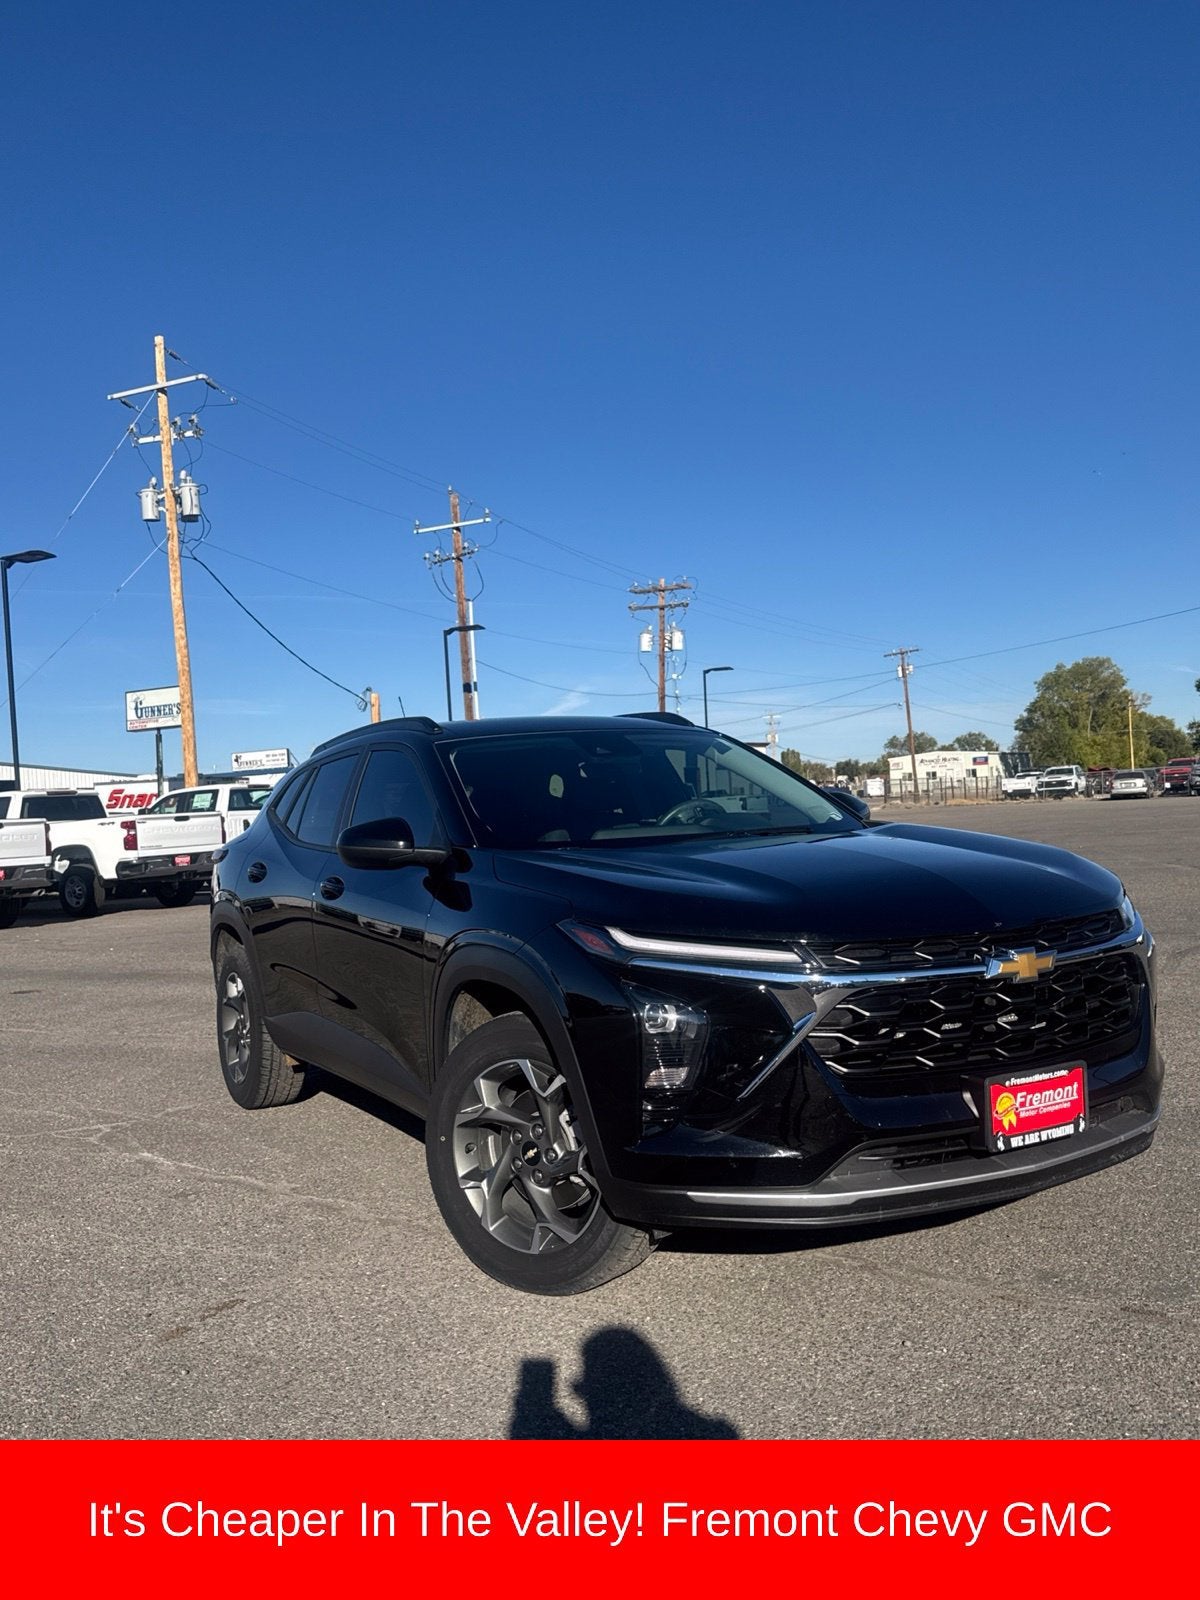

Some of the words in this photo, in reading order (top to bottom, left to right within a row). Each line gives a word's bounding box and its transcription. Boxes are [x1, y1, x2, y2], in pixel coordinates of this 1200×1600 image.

[134, 700, 181, 719] GUNNER'S
[1016, 1082, 1079, 1107] Fremont
[1019, 1108, 1038, 1118] Motor
[1039, 1102, 1071, 1115] Companies
[1010, 1136, 1024, 1148] WE
[1025, 1132, 1041, 1146] ARE
[1041, 1123, 1075, 1142] WYOMING
